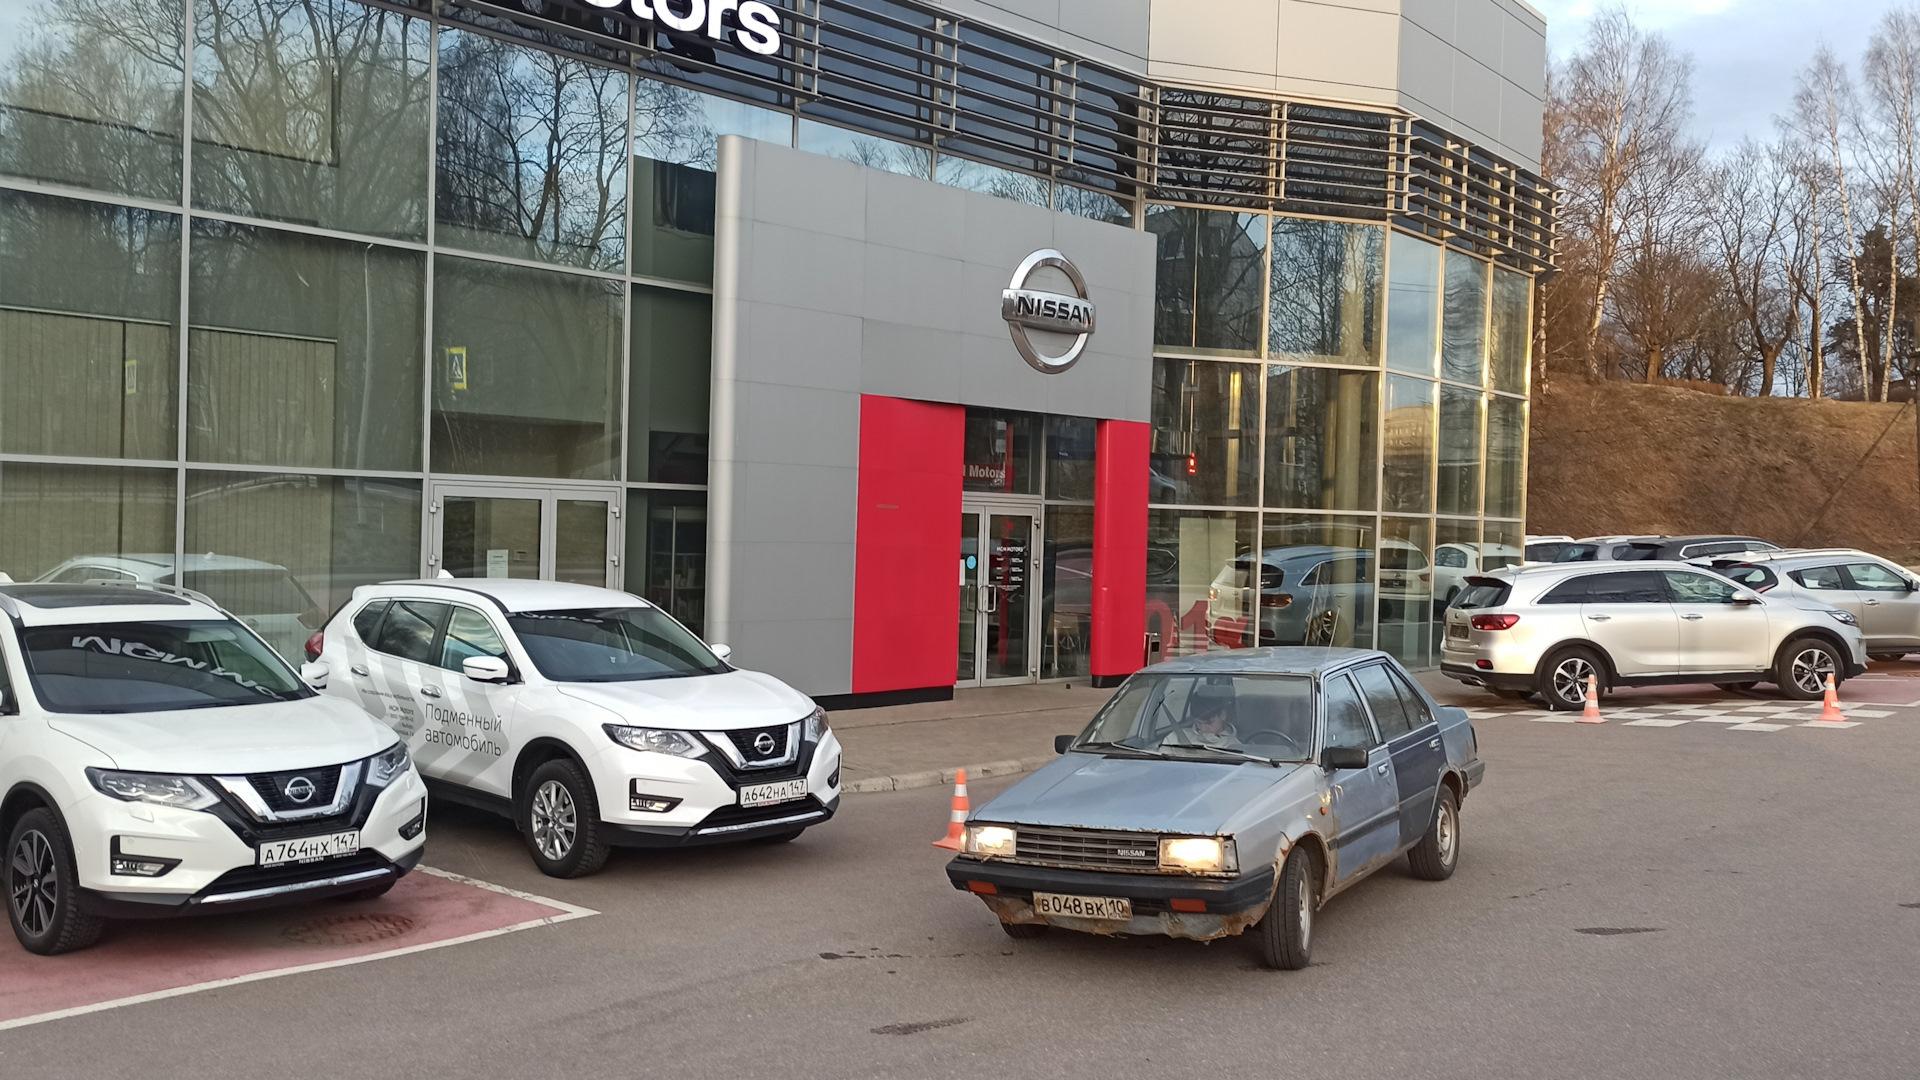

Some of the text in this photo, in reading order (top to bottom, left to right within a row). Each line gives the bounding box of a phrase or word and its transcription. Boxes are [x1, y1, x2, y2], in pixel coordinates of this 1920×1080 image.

[1017, 296, 1092, 325] NISSAN
[969, 464, 1005, 479] Motors
[425, 703, 502, 733] Подменный
[425, 728, 502, 756] автомобиль
[1117, 849, 1146, 857] NISSAN
